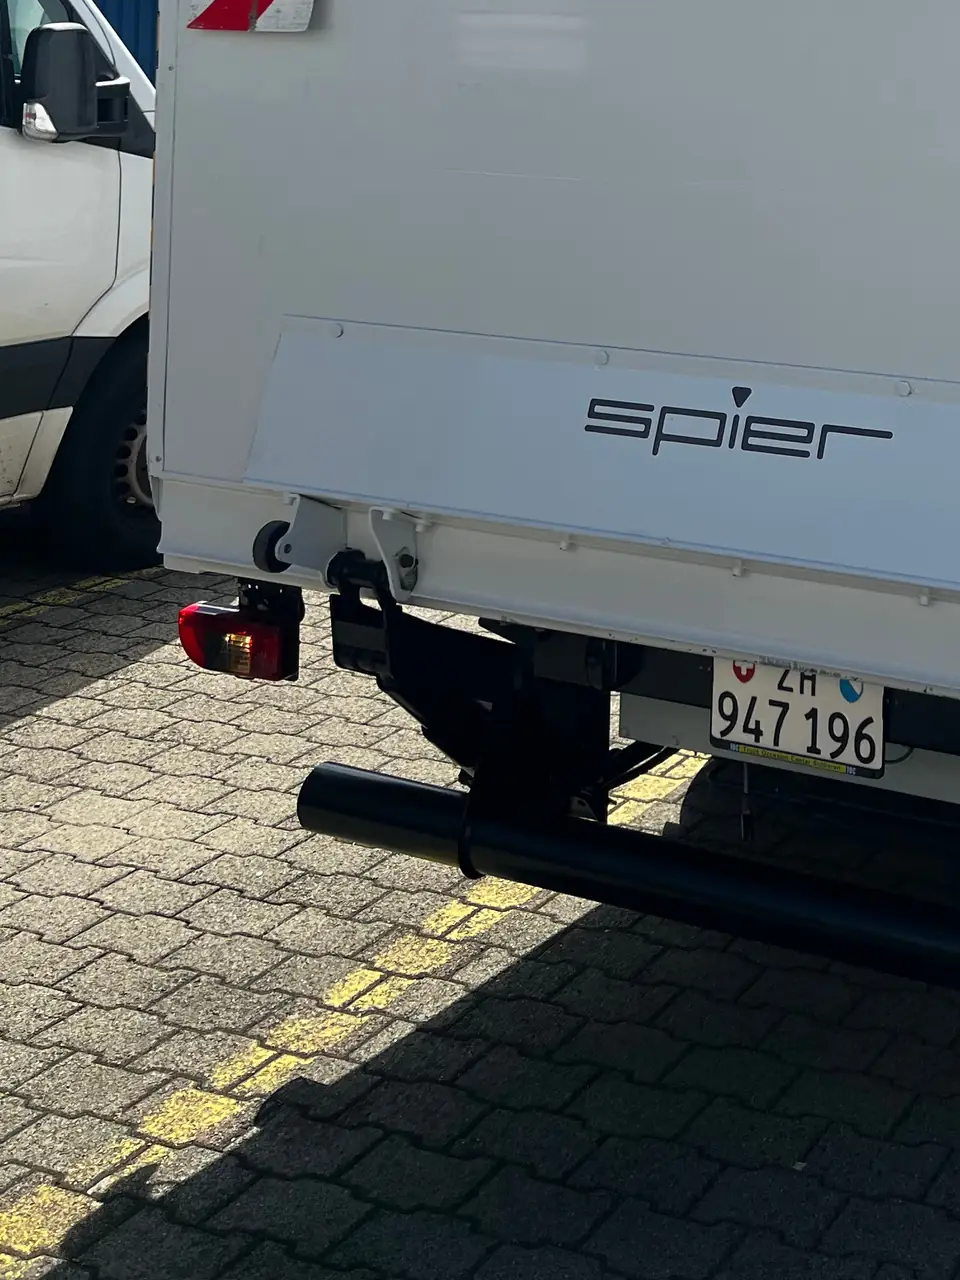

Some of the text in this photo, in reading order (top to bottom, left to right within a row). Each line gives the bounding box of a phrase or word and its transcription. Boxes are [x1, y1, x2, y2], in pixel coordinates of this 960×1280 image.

[585, 386, 893, 459] spier
[718, 691, 876, 764] 947 196
